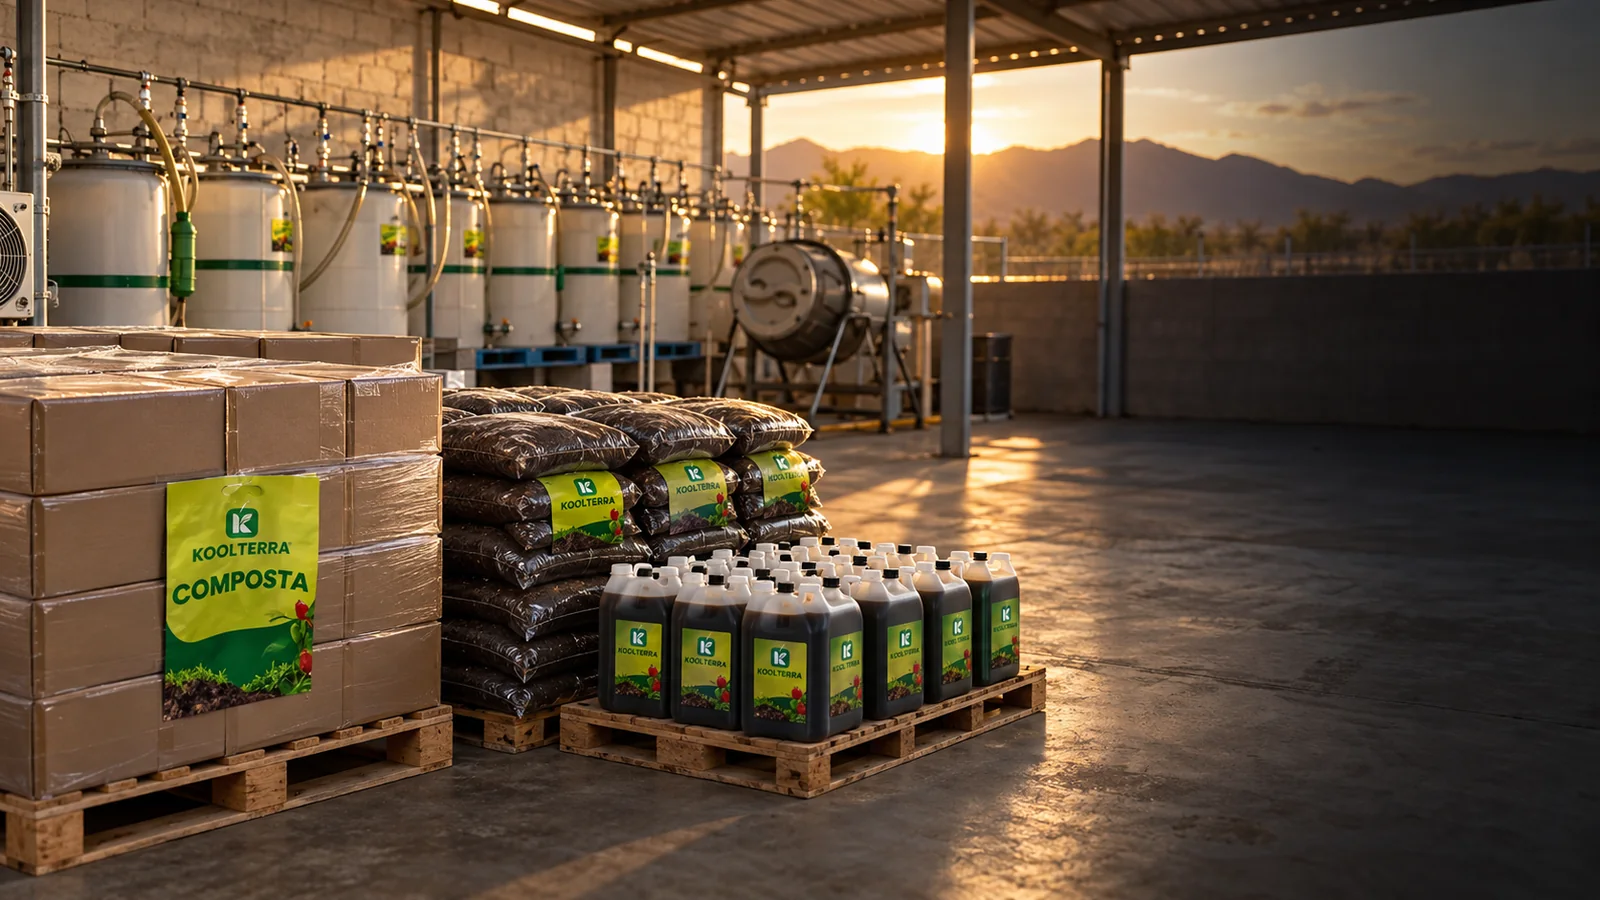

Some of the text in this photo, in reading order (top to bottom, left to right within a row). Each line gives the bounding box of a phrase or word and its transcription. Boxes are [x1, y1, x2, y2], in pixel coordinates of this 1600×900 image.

[578, 481, 594, 494] K
[676, 482, 721, 495] KOOLTERRA
[560, 496, 616, 510] KOOLTERRA
[232, 513, 253, 534] K
[192, 541, 291, 563] KOOLTERRA
[172, 569, 309, 605] COMPOSTA
[632, 631, 645, 645] K
[700, 640, 712, 655] K
[684, 656, 727, 668] KOOLTERRA
[773, 650, 787, 666] K
[757, 668, 803, 680] KOOLTERRA
